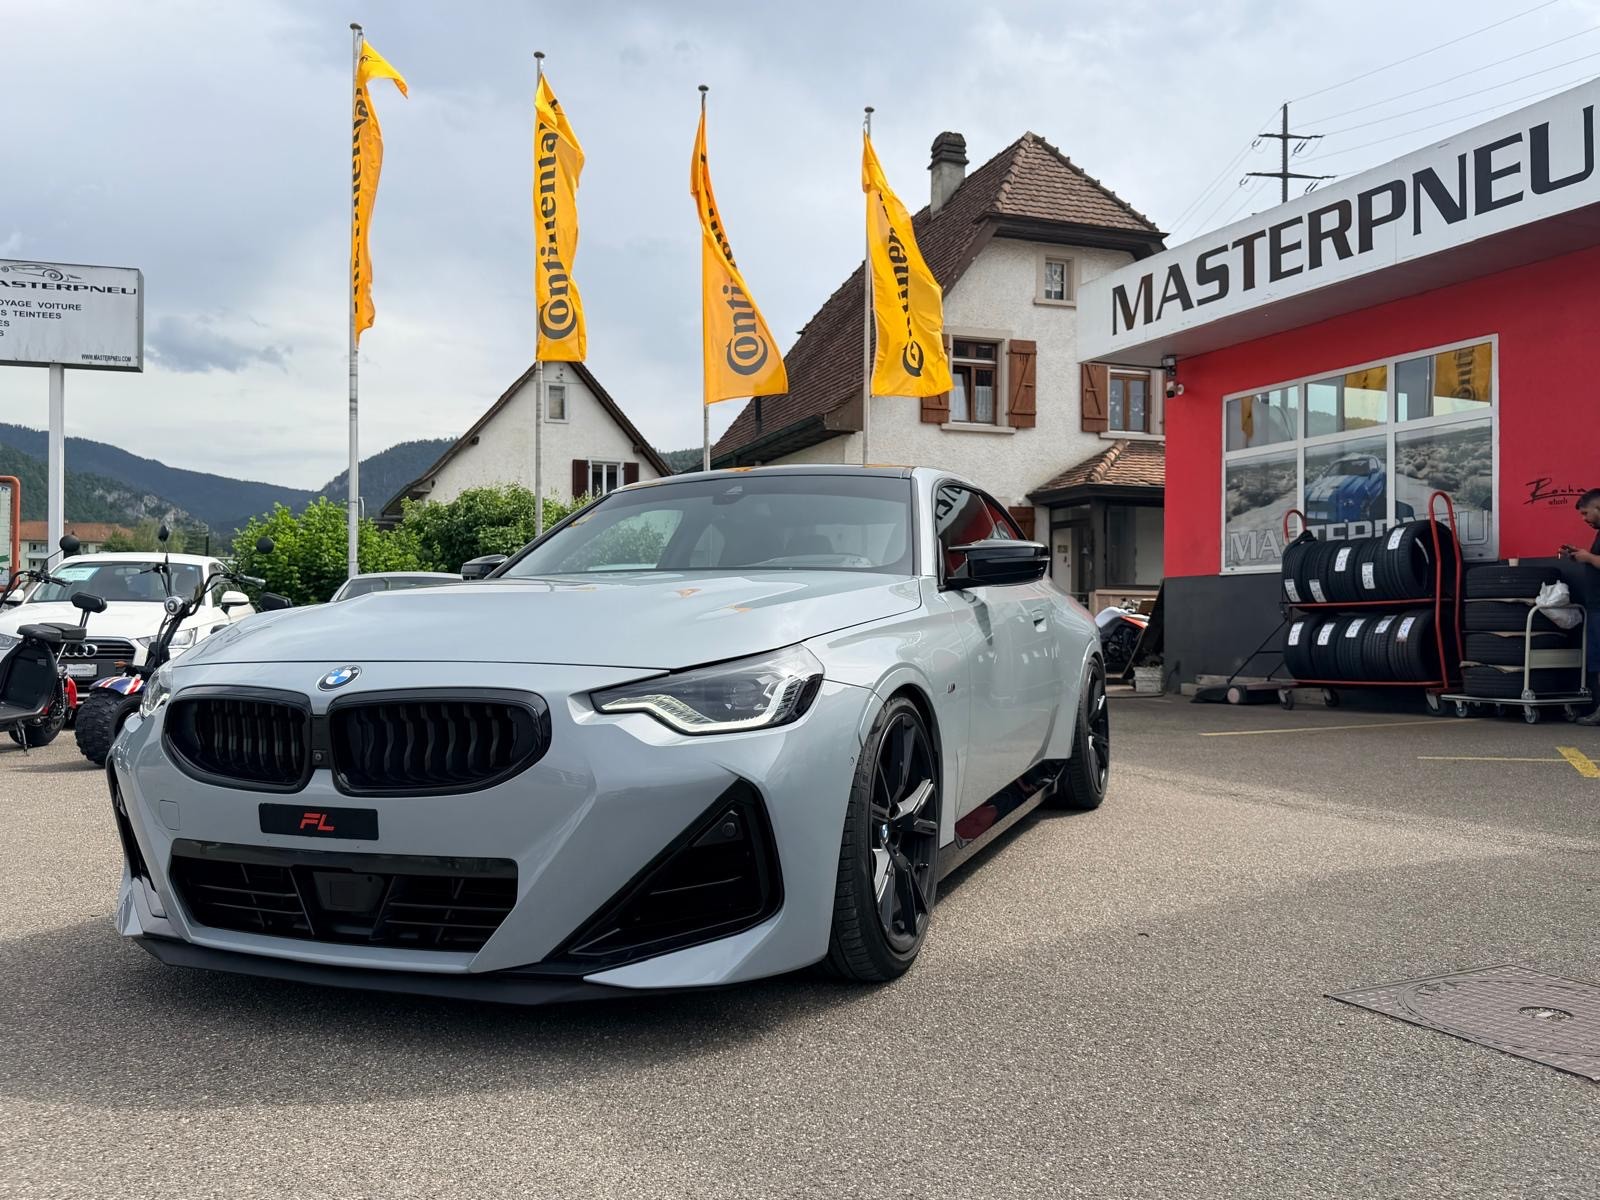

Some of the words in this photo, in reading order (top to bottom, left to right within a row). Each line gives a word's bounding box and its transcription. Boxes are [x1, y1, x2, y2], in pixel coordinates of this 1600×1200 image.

[1112, 105, 1594, 336] MASTERPNEU
[38, 302, 82, 311] VOITURE
[13, 310, 62, 319] TEINTEES
[81, 353, 132, 362] WWW.MASTERPNEU.COM
[300, 812, 336, 832] FL
